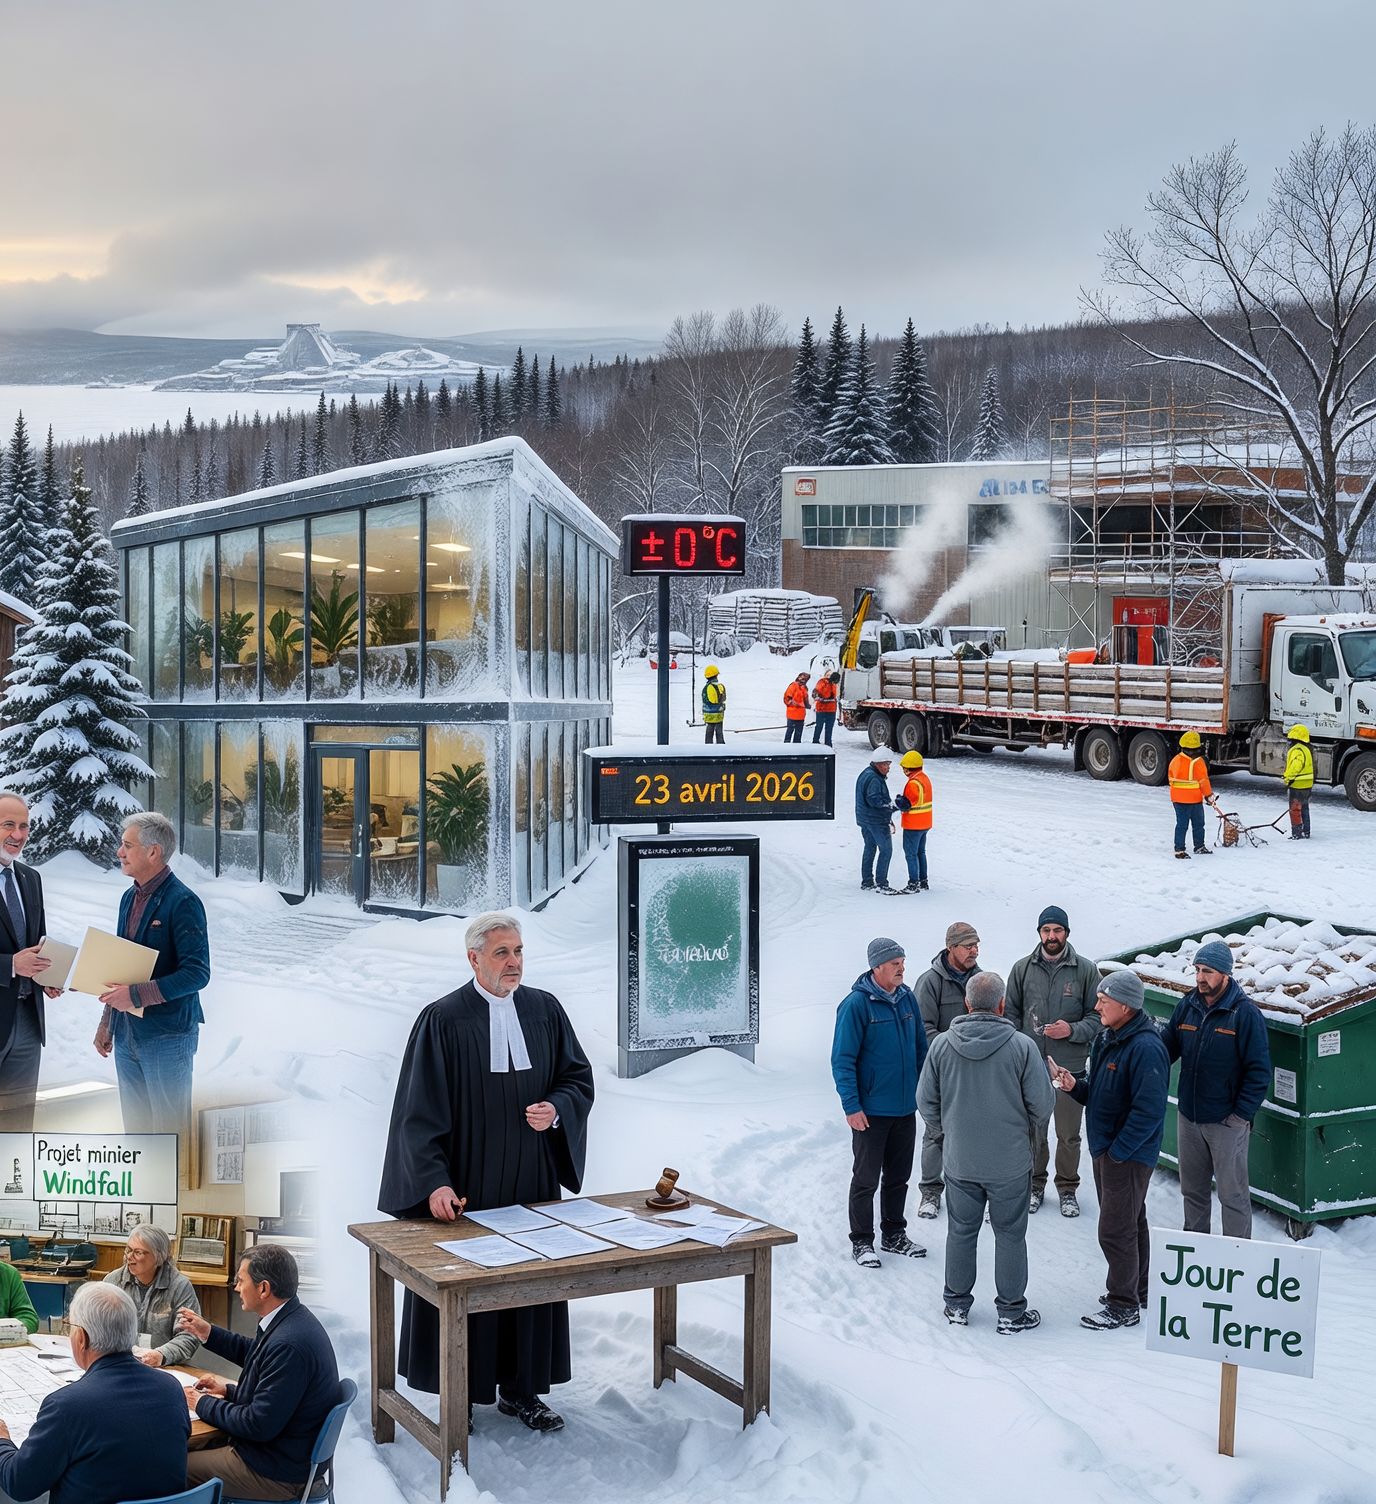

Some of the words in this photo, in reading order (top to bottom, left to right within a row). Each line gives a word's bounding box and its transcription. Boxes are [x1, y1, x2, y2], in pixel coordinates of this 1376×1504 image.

[634, 774, 671, 804] 23
[679, 773, 735, 803] avril
[745, 771, 815, 802] 2026
[37, 1139, 81, 1166] Projet
[88, 1145, 141, 1164] minier
[42, 1169, 133, 1197] Windfall
[1160, 1244, 1245, 1293] Jour
[1256, 1257, 1301, 1303] de
[1159, 1296, 1191, 1340] la
[1202, 1301, 1303, 1357] Terre
